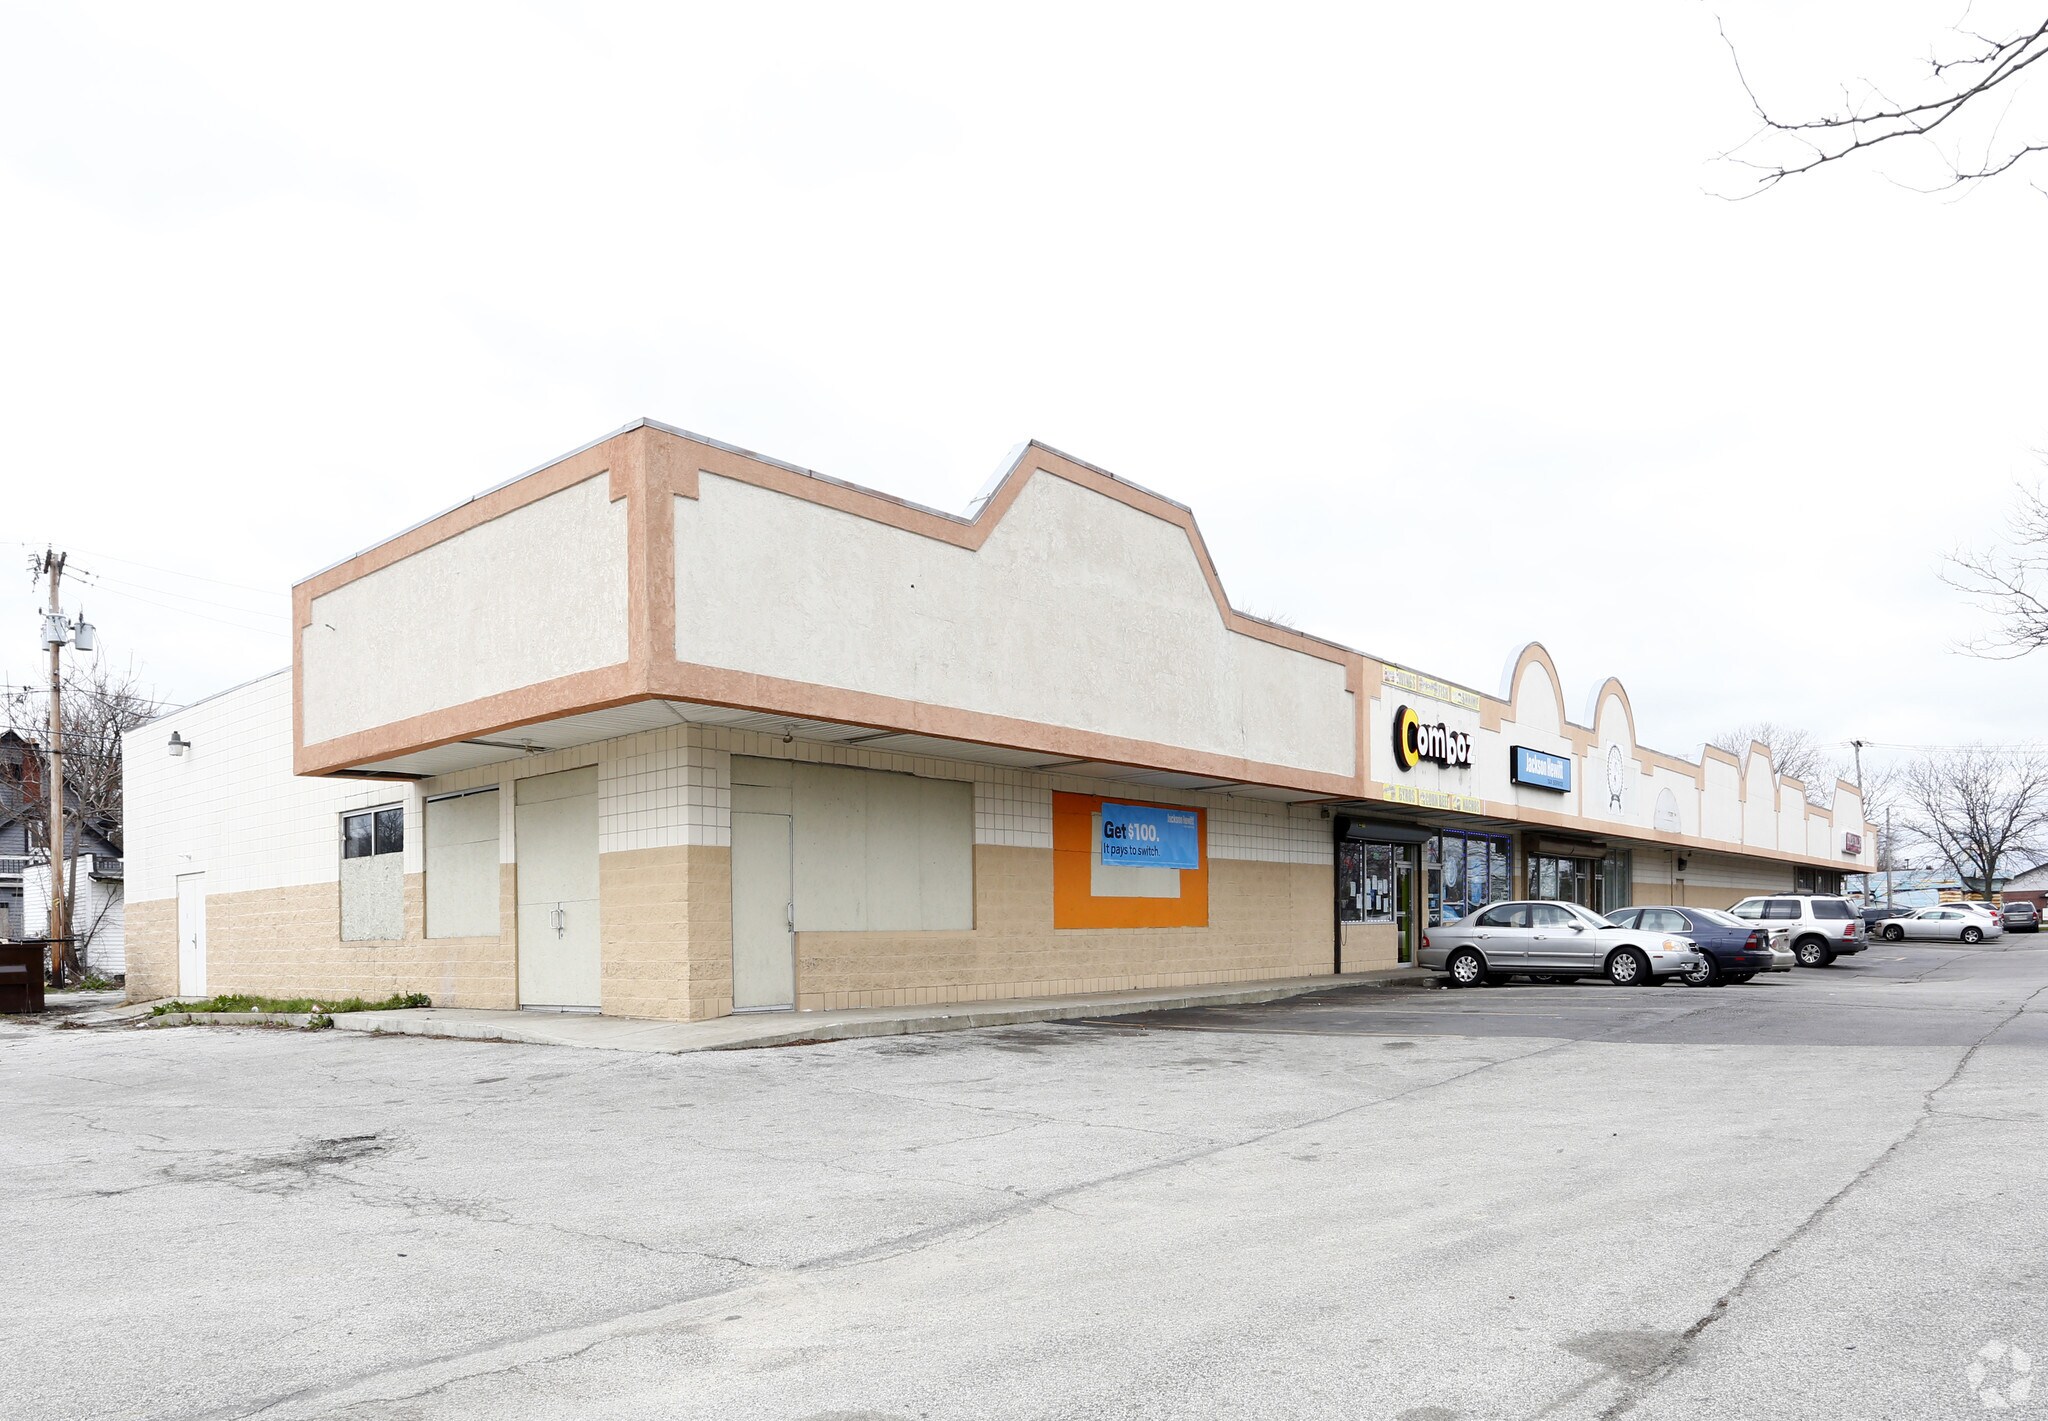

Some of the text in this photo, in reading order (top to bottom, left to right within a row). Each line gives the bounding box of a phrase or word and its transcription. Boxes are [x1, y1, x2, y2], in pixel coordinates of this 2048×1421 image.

[1525, 752, 1547, 776] Jackson
[1104, 821, 1160, 842] Get $100.
[1103, 843, 1160, 858] It pays to switch.
